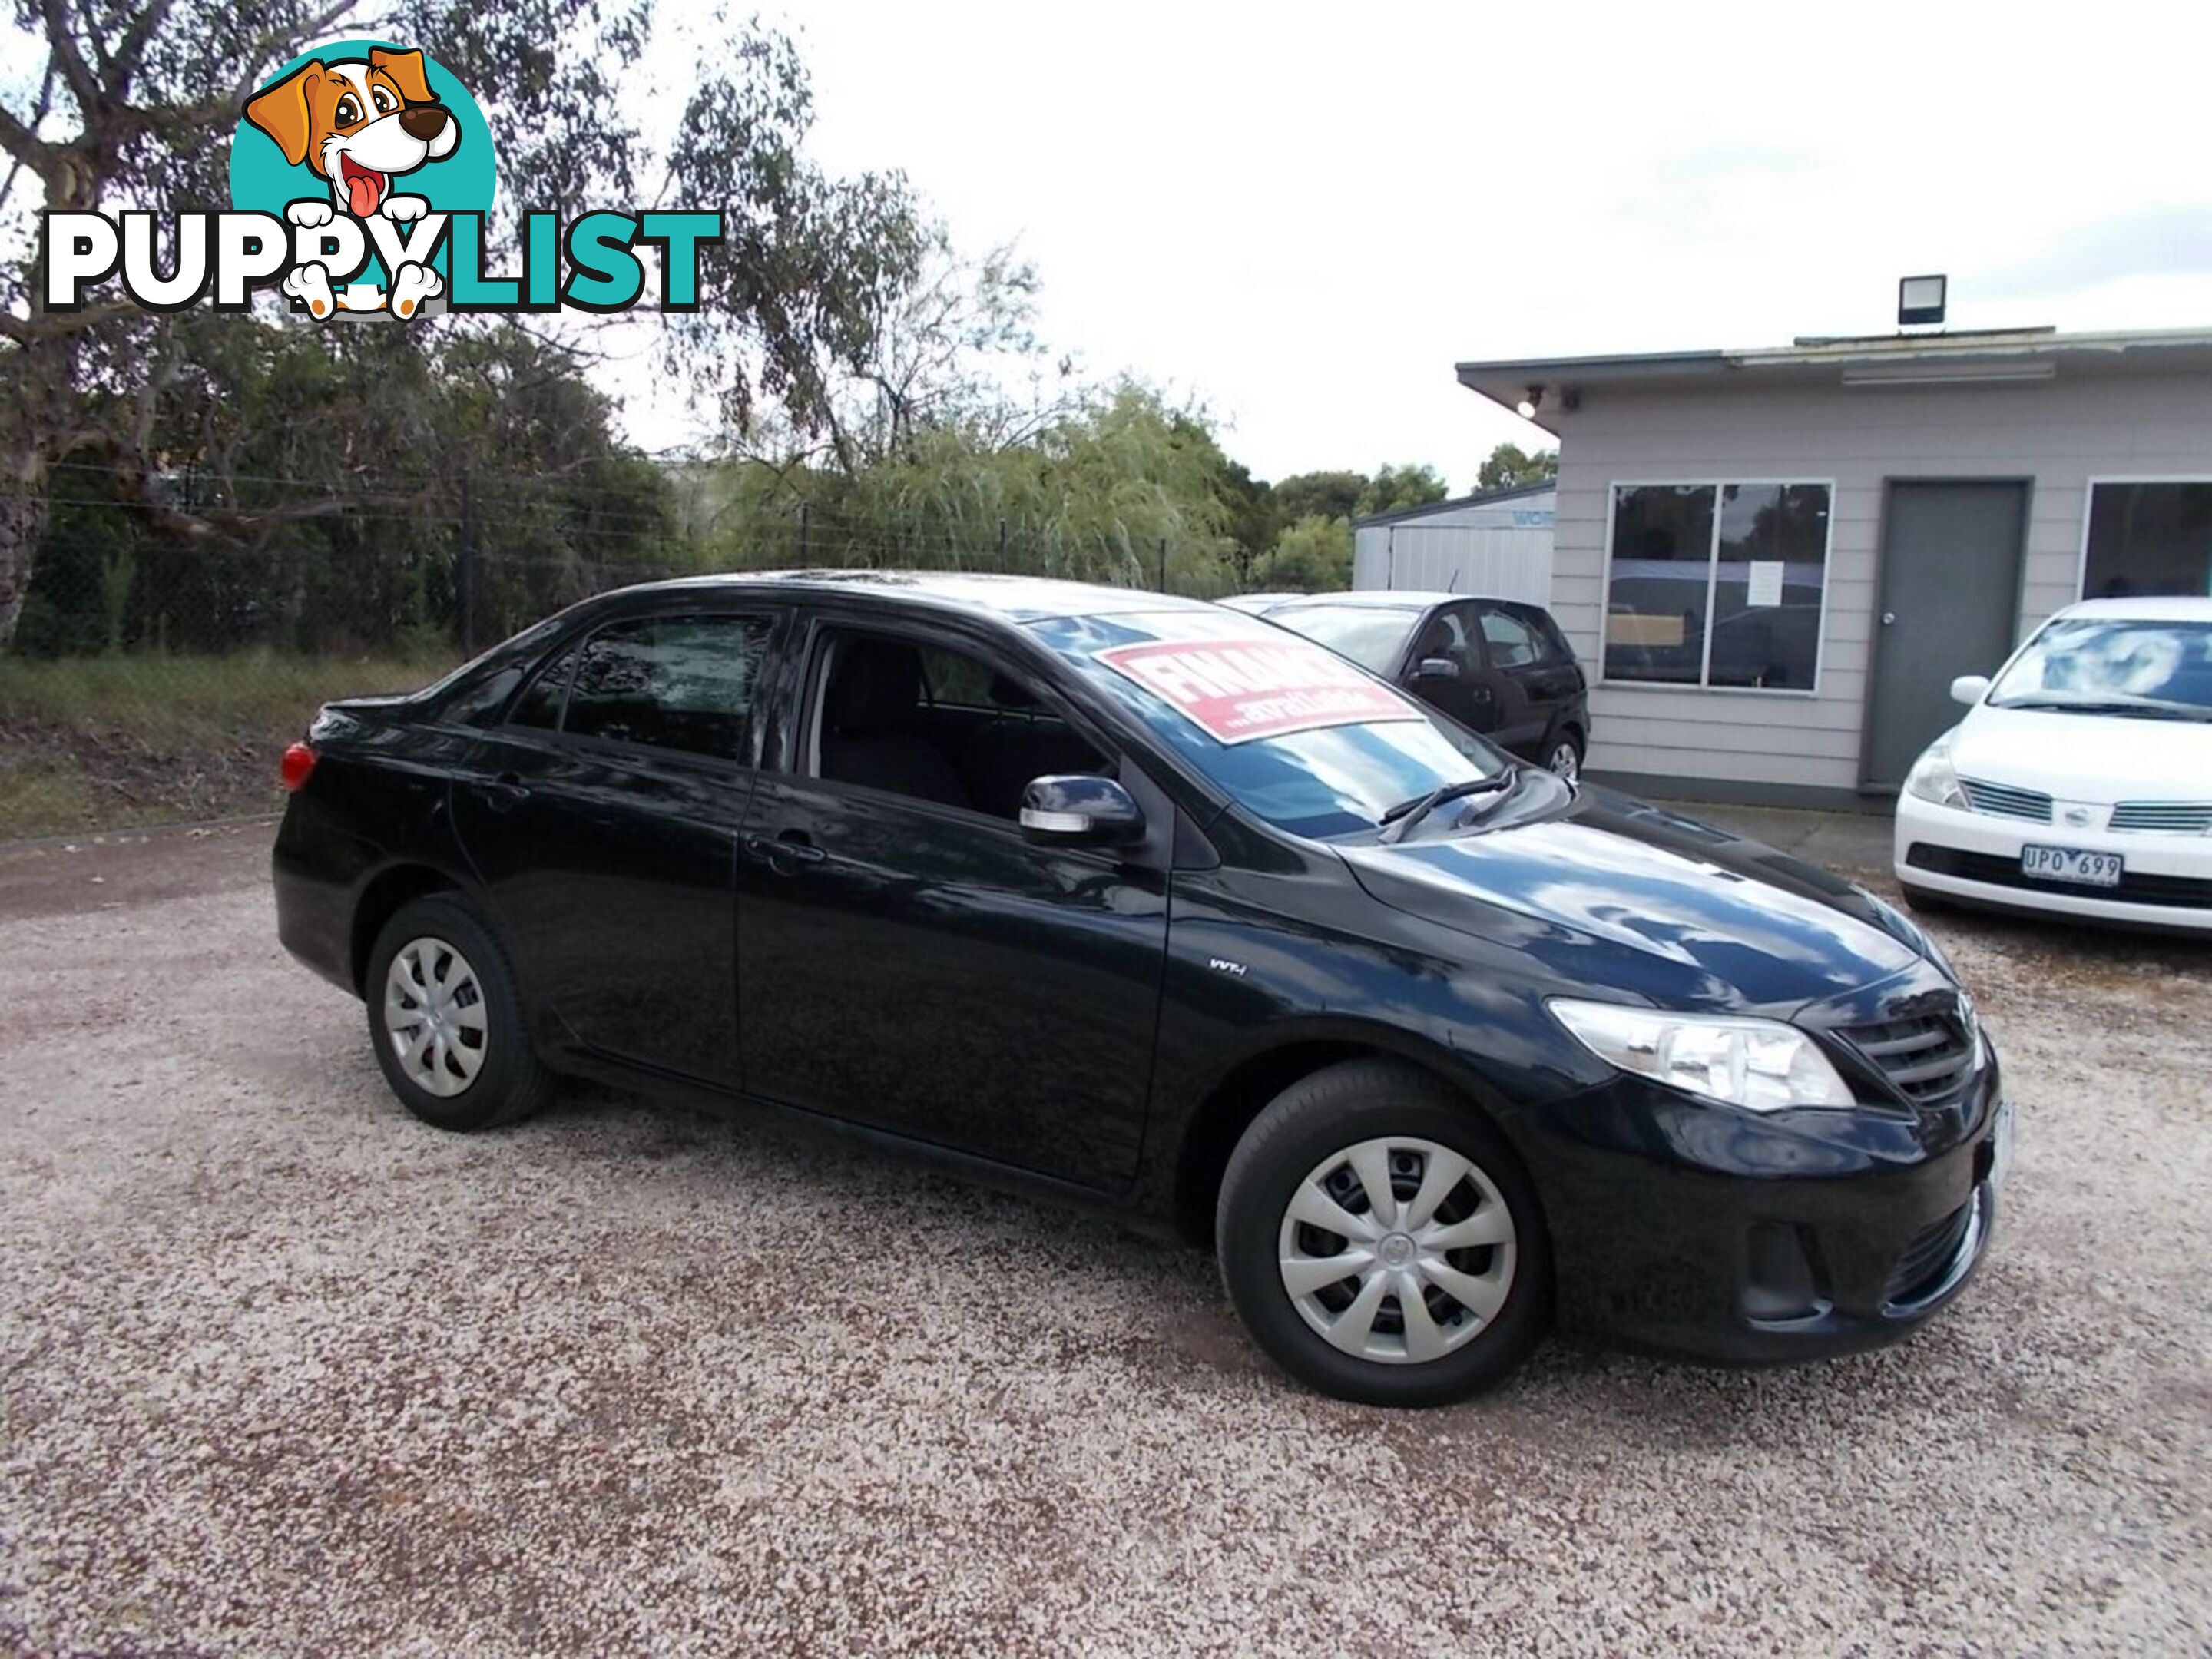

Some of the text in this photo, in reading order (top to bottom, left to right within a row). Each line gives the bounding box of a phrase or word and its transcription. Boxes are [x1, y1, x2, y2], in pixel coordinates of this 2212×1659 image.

[1124, 647, 1369, 703] FINAN
[2025, 849, 2118, 876] UPO 699
